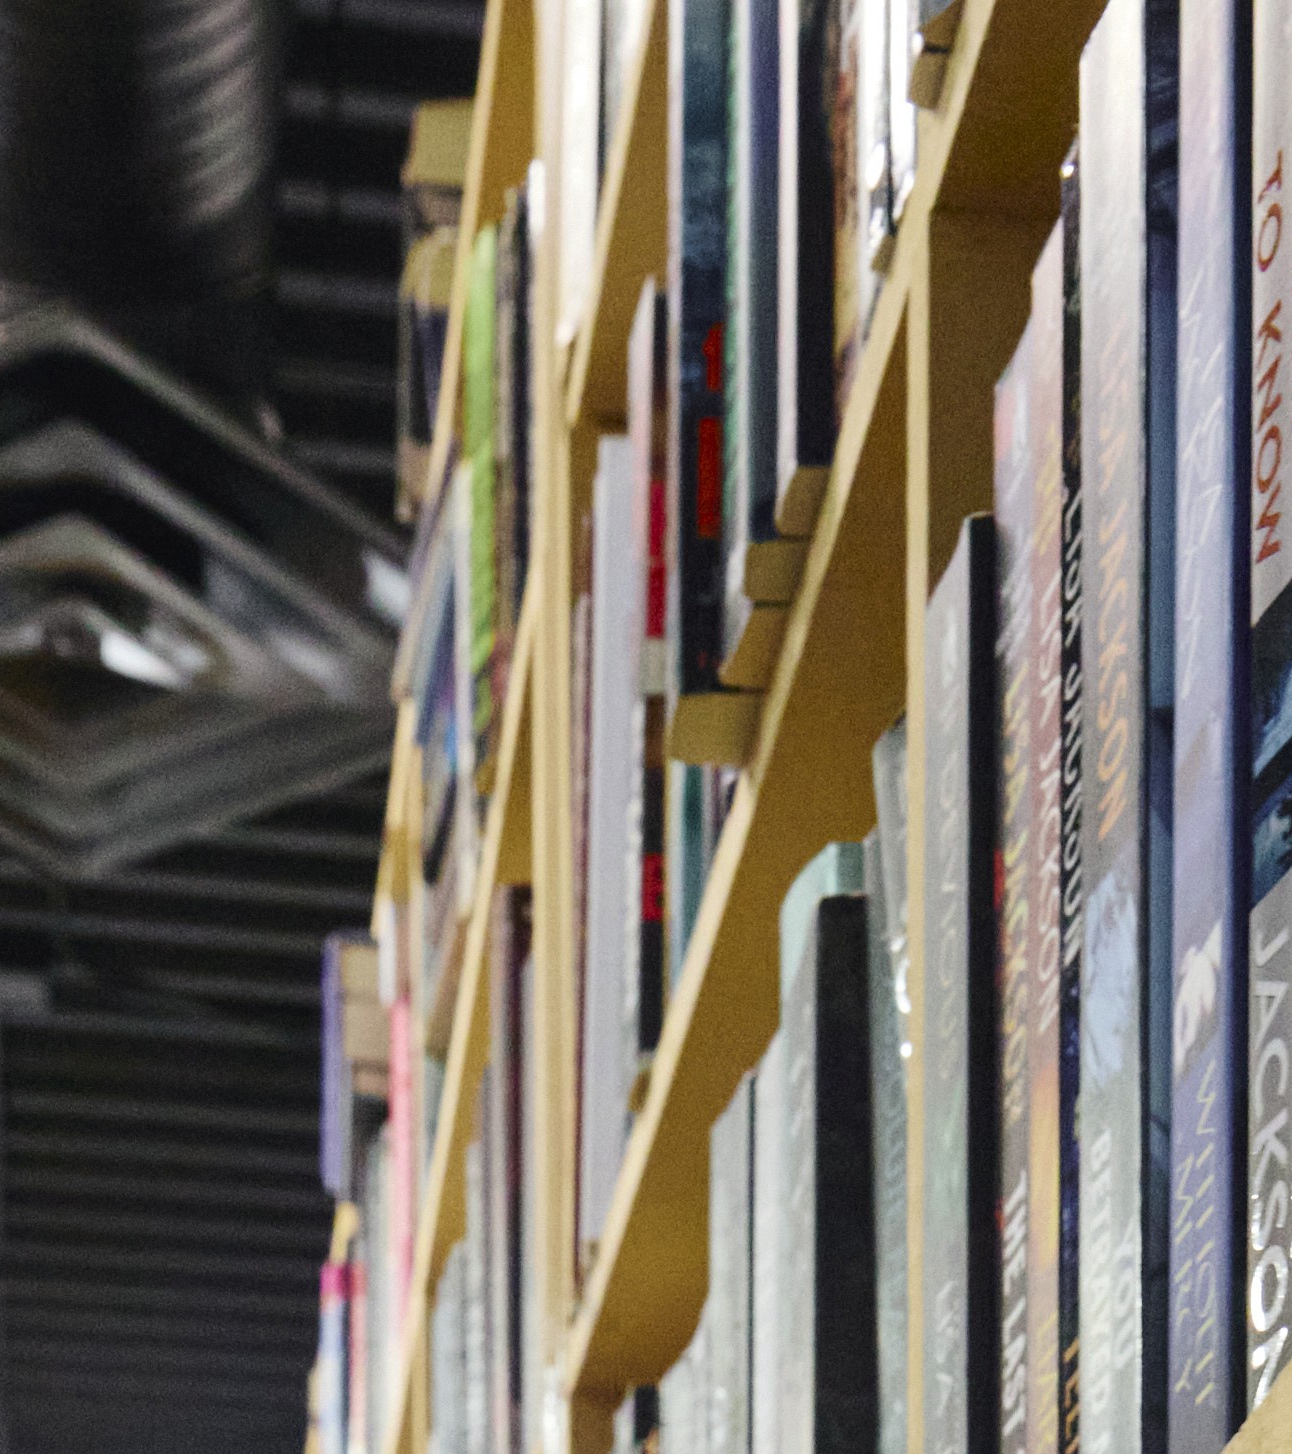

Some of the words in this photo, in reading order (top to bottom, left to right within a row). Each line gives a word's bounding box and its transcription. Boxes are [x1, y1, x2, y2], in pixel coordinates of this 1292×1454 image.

[1257, 148, 1284, 272] TO
[1255, 300, 1284, 563] KNOW
[1096, 499, 1131, 845] JACKSON
[1037, 737, 1062, 1036] JACKSON
[1002, 1170, 1027, 1296] THE
[1250, 925, 1292, 1412] JACKSON
[1002, 1298, 1027, 1438] LAST
